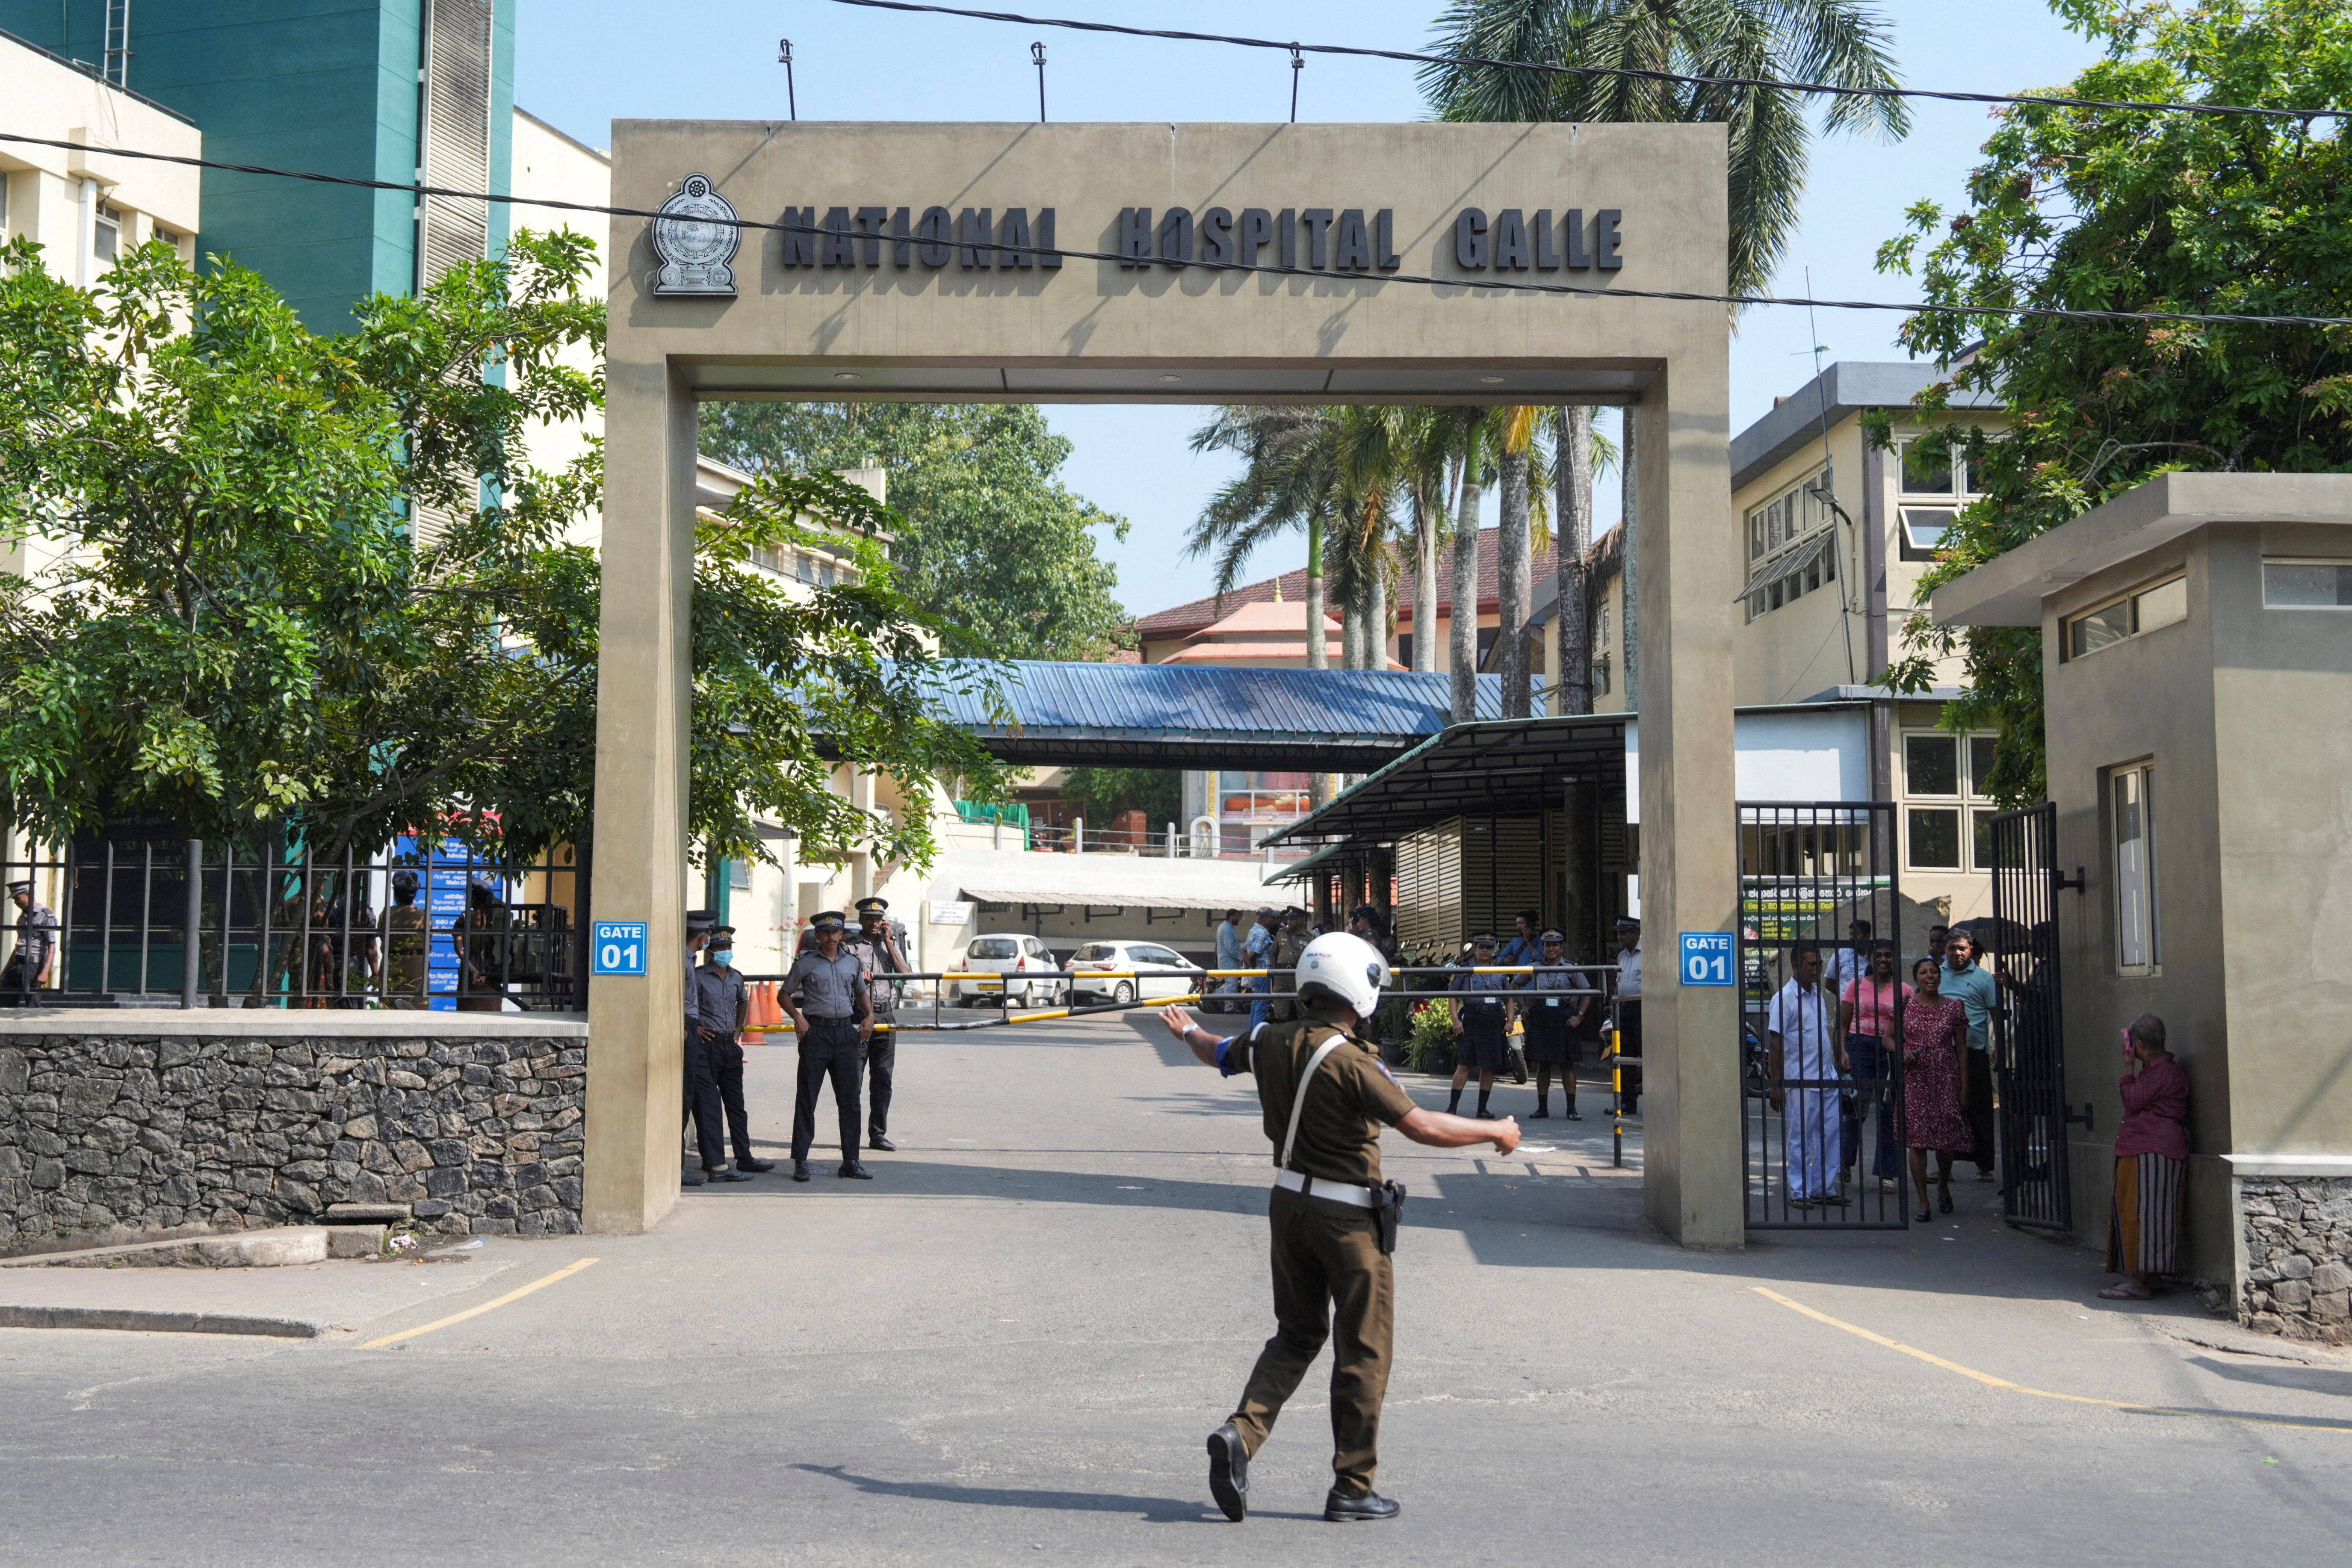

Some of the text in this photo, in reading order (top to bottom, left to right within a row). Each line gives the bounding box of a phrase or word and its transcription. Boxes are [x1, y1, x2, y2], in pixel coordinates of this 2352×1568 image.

[784, 206, 1622, 269] NATIONAL HOSPITAL GALLE
[600, 927, 641, 938] GATE
[1686, 938, 1729, 949] GATE
[601, 944, 637, 968] 01
[1689, 956, 1725, 980] 01
